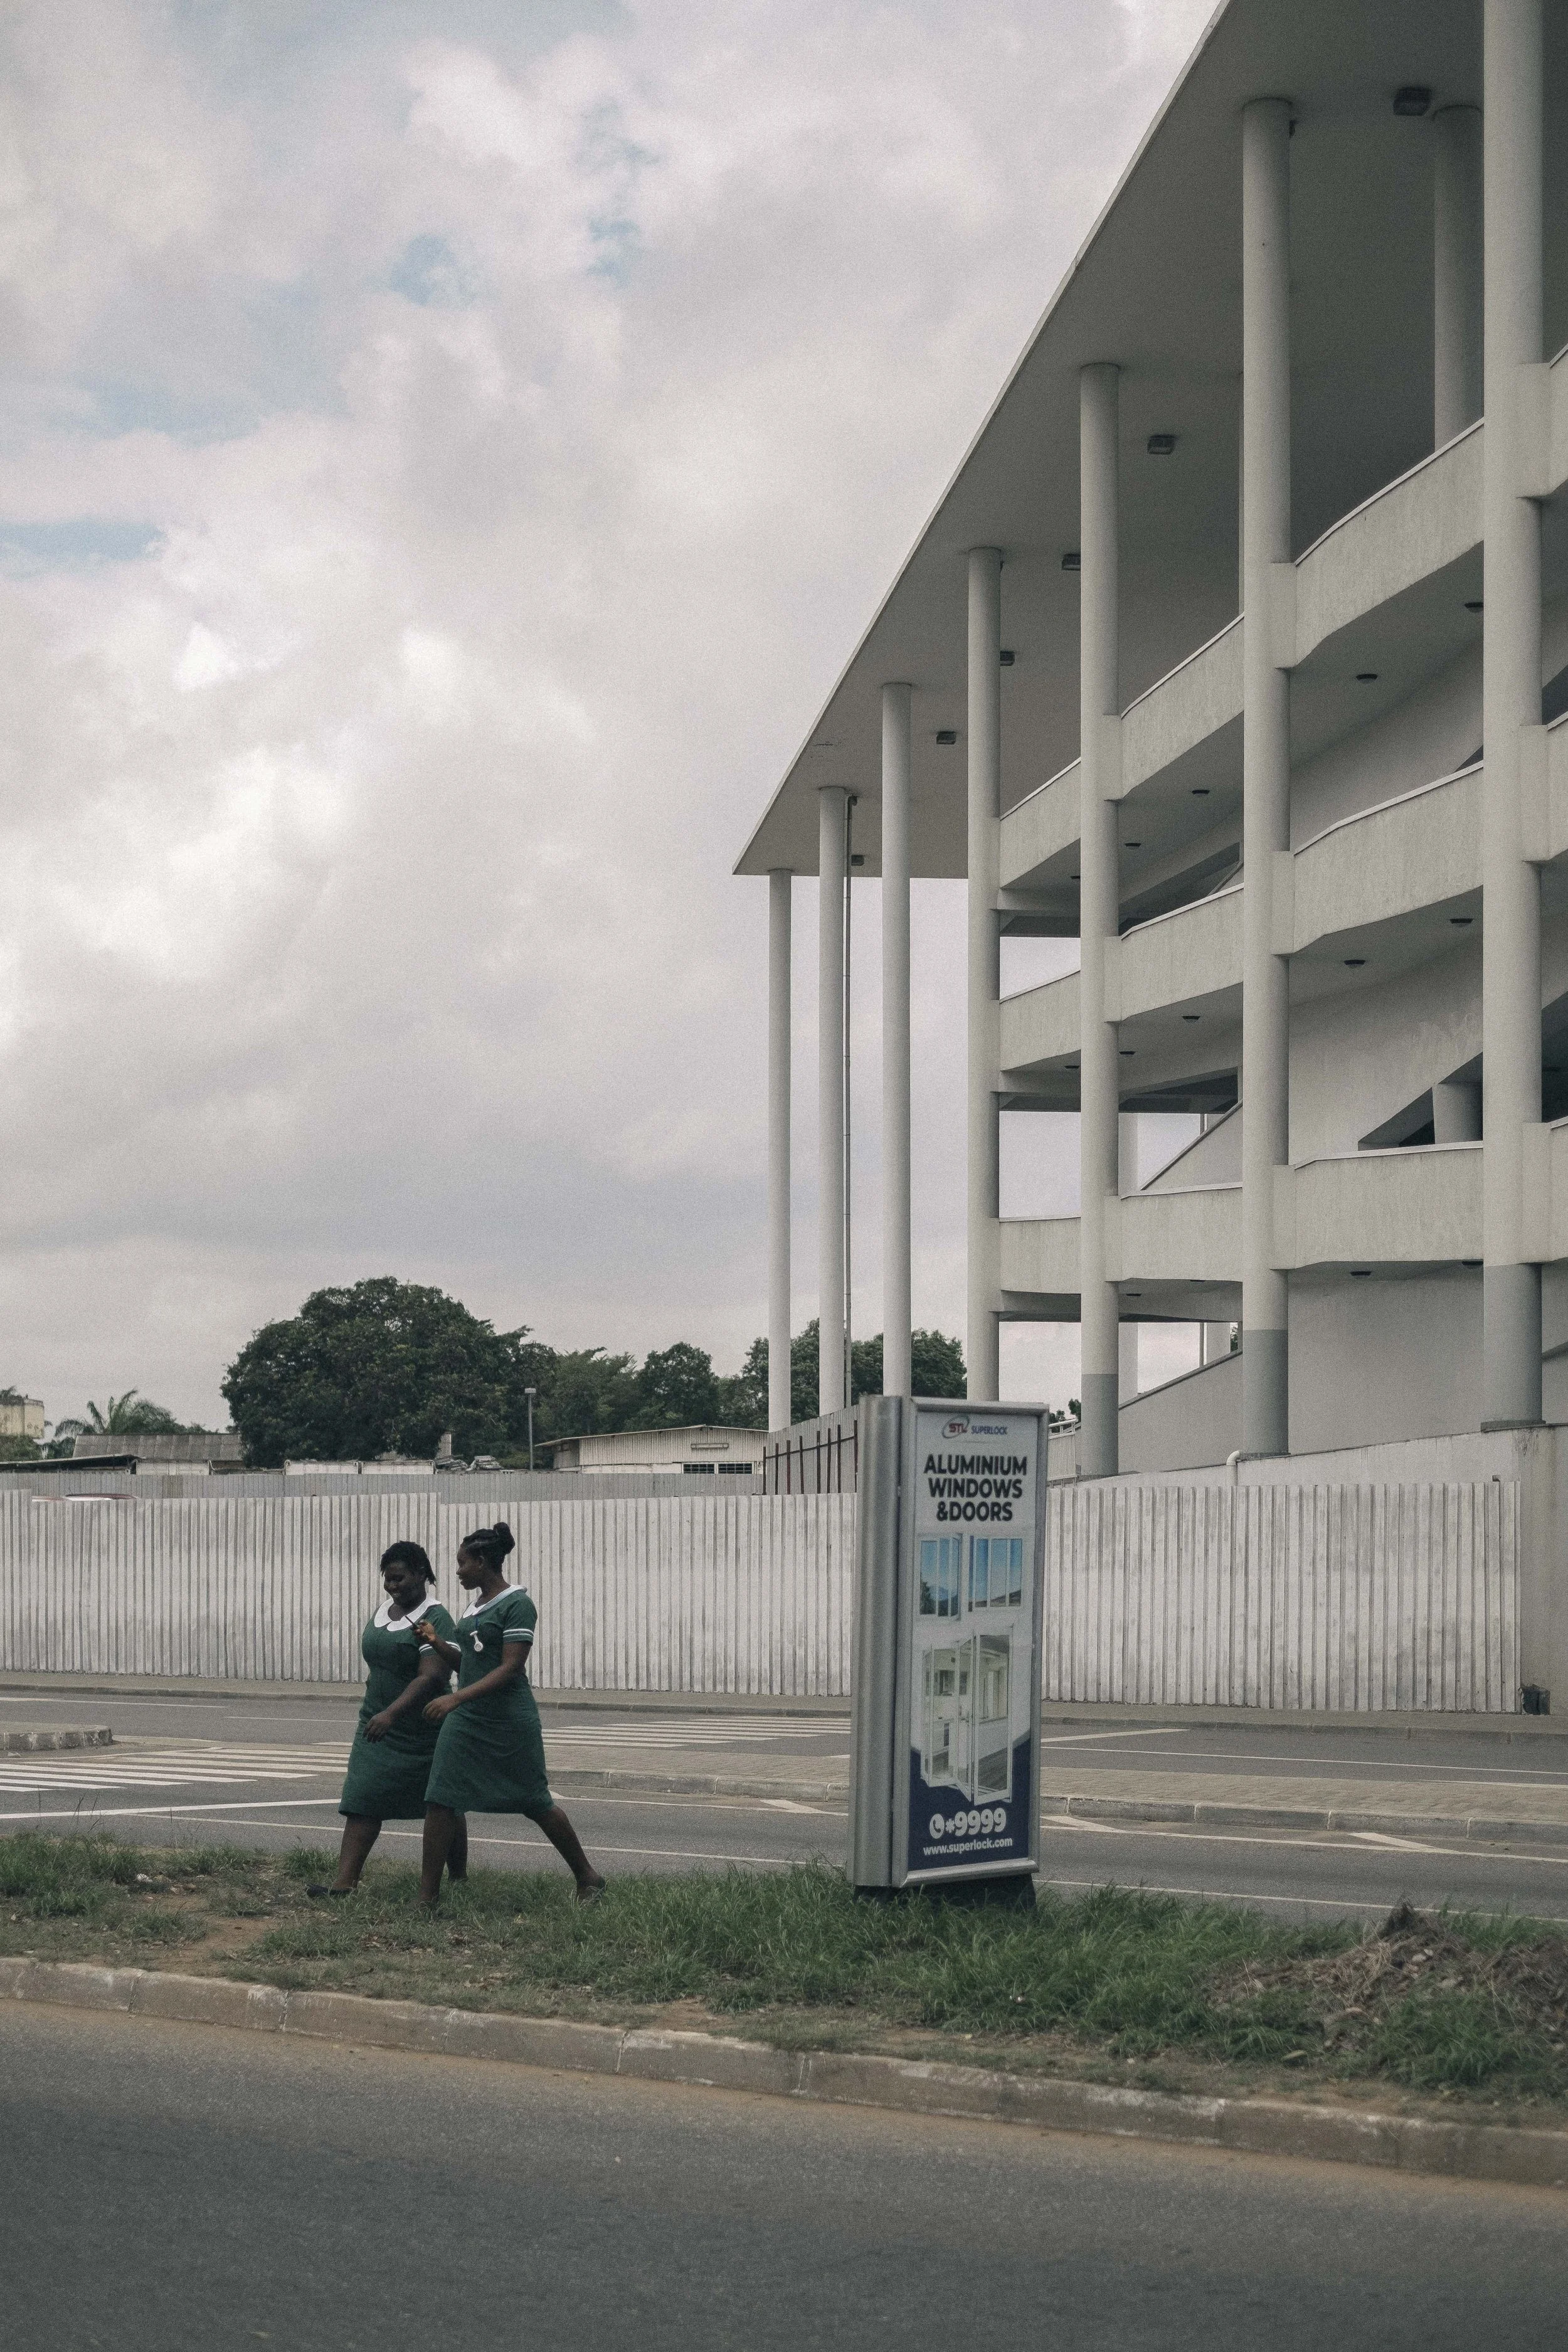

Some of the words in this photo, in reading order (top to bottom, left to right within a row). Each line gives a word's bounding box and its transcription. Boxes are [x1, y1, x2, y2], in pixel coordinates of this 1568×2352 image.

[971, 1426, 1007, 1435] SUPERLOCK
[923, 1453, 1027, 1475] ALUMINIUM
[928, 1477, 1023, 1499] WINDOWS
[936, 1502, 1013, 1522] &DOORS
[923, 1838, 1013, 1856] www.superlock.com
